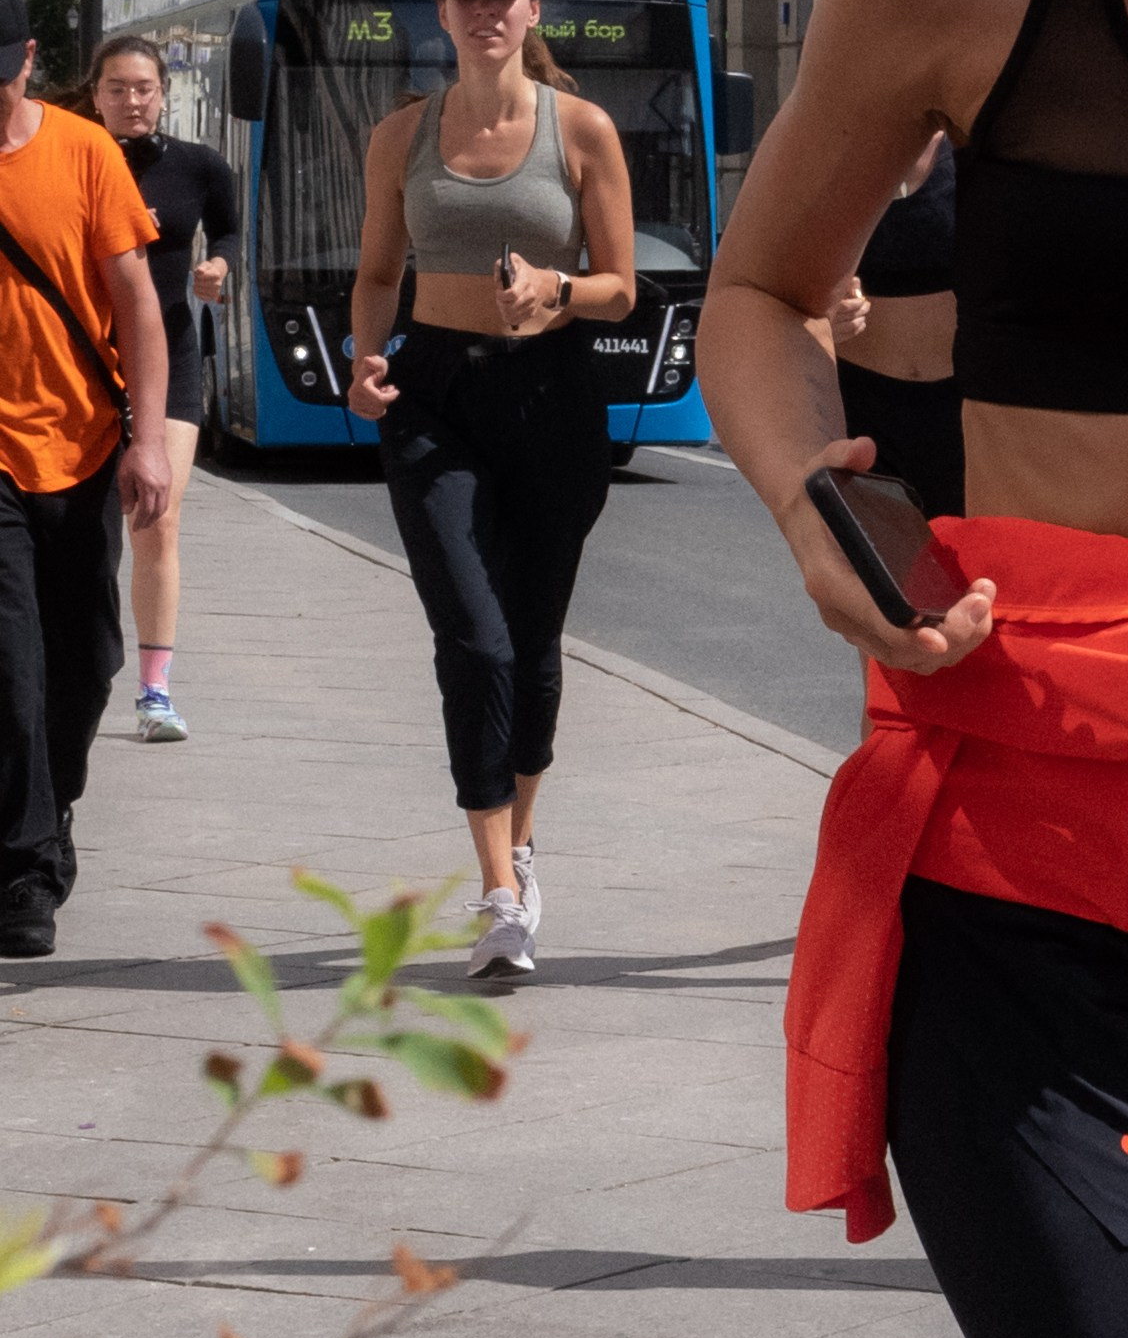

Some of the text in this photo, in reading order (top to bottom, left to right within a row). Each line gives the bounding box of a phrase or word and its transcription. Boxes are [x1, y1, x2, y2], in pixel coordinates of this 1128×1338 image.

[534, 19, 625, 42] ный бор
[593, 338, 649, 353] 411441
